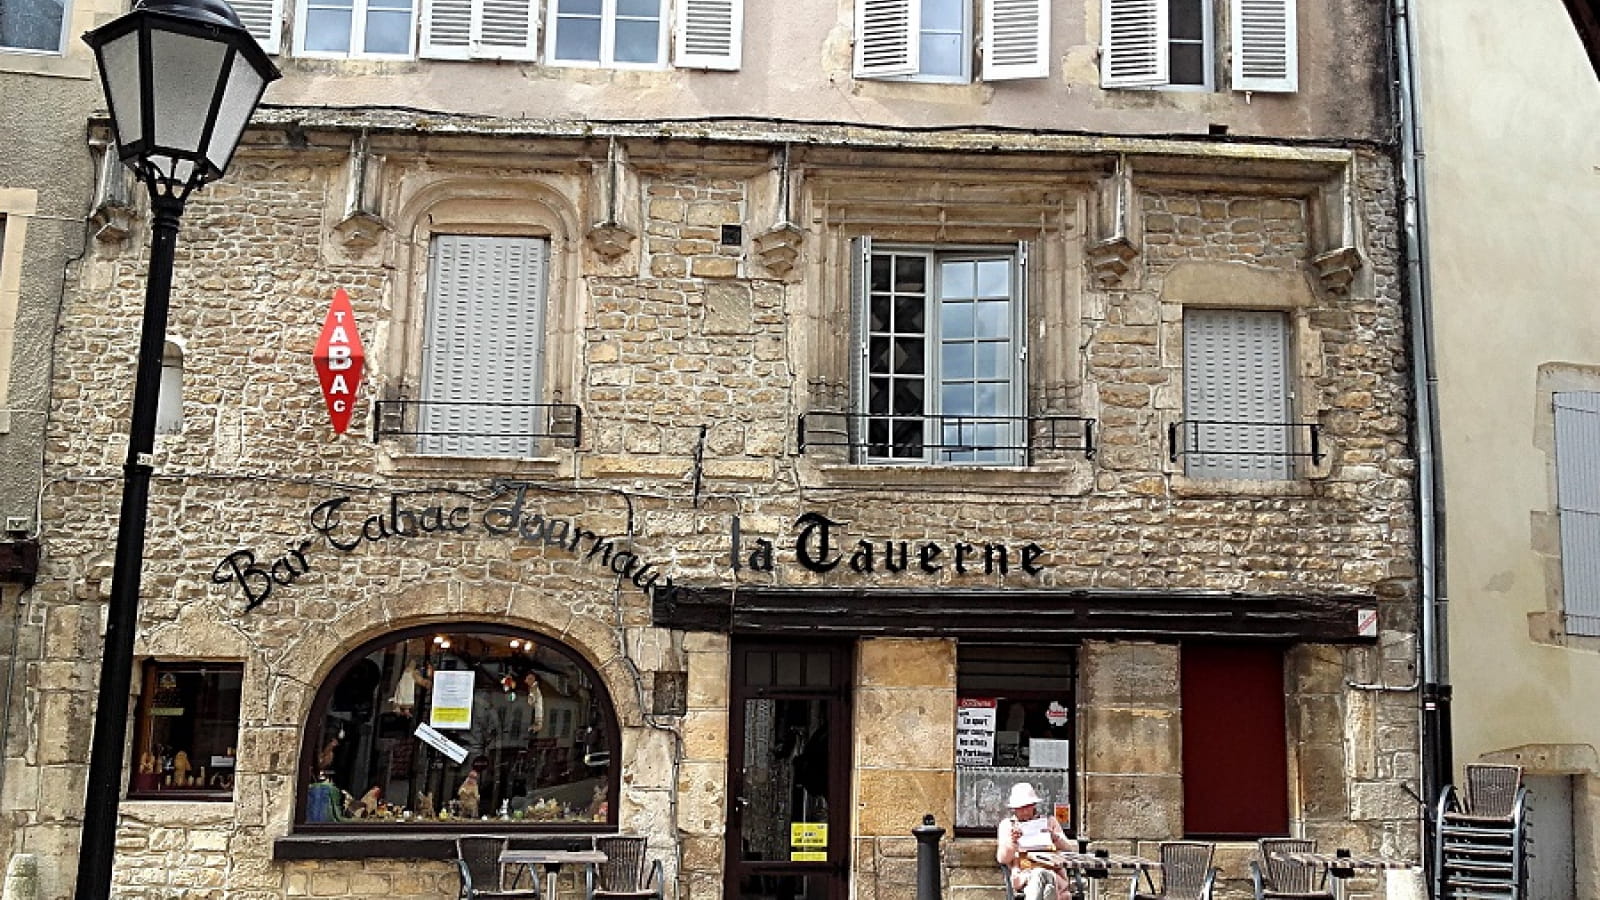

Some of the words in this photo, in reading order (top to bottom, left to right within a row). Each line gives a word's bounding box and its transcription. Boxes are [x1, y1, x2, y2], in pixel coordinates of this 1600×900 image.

[328, 311, 353, 412] TABAC
[212, 541, 311, 614] Bar
[311, 493, 470, 552] Tabac
[731, 515, 774, 572] la
[792, 512, 1046, 576] Taverne
